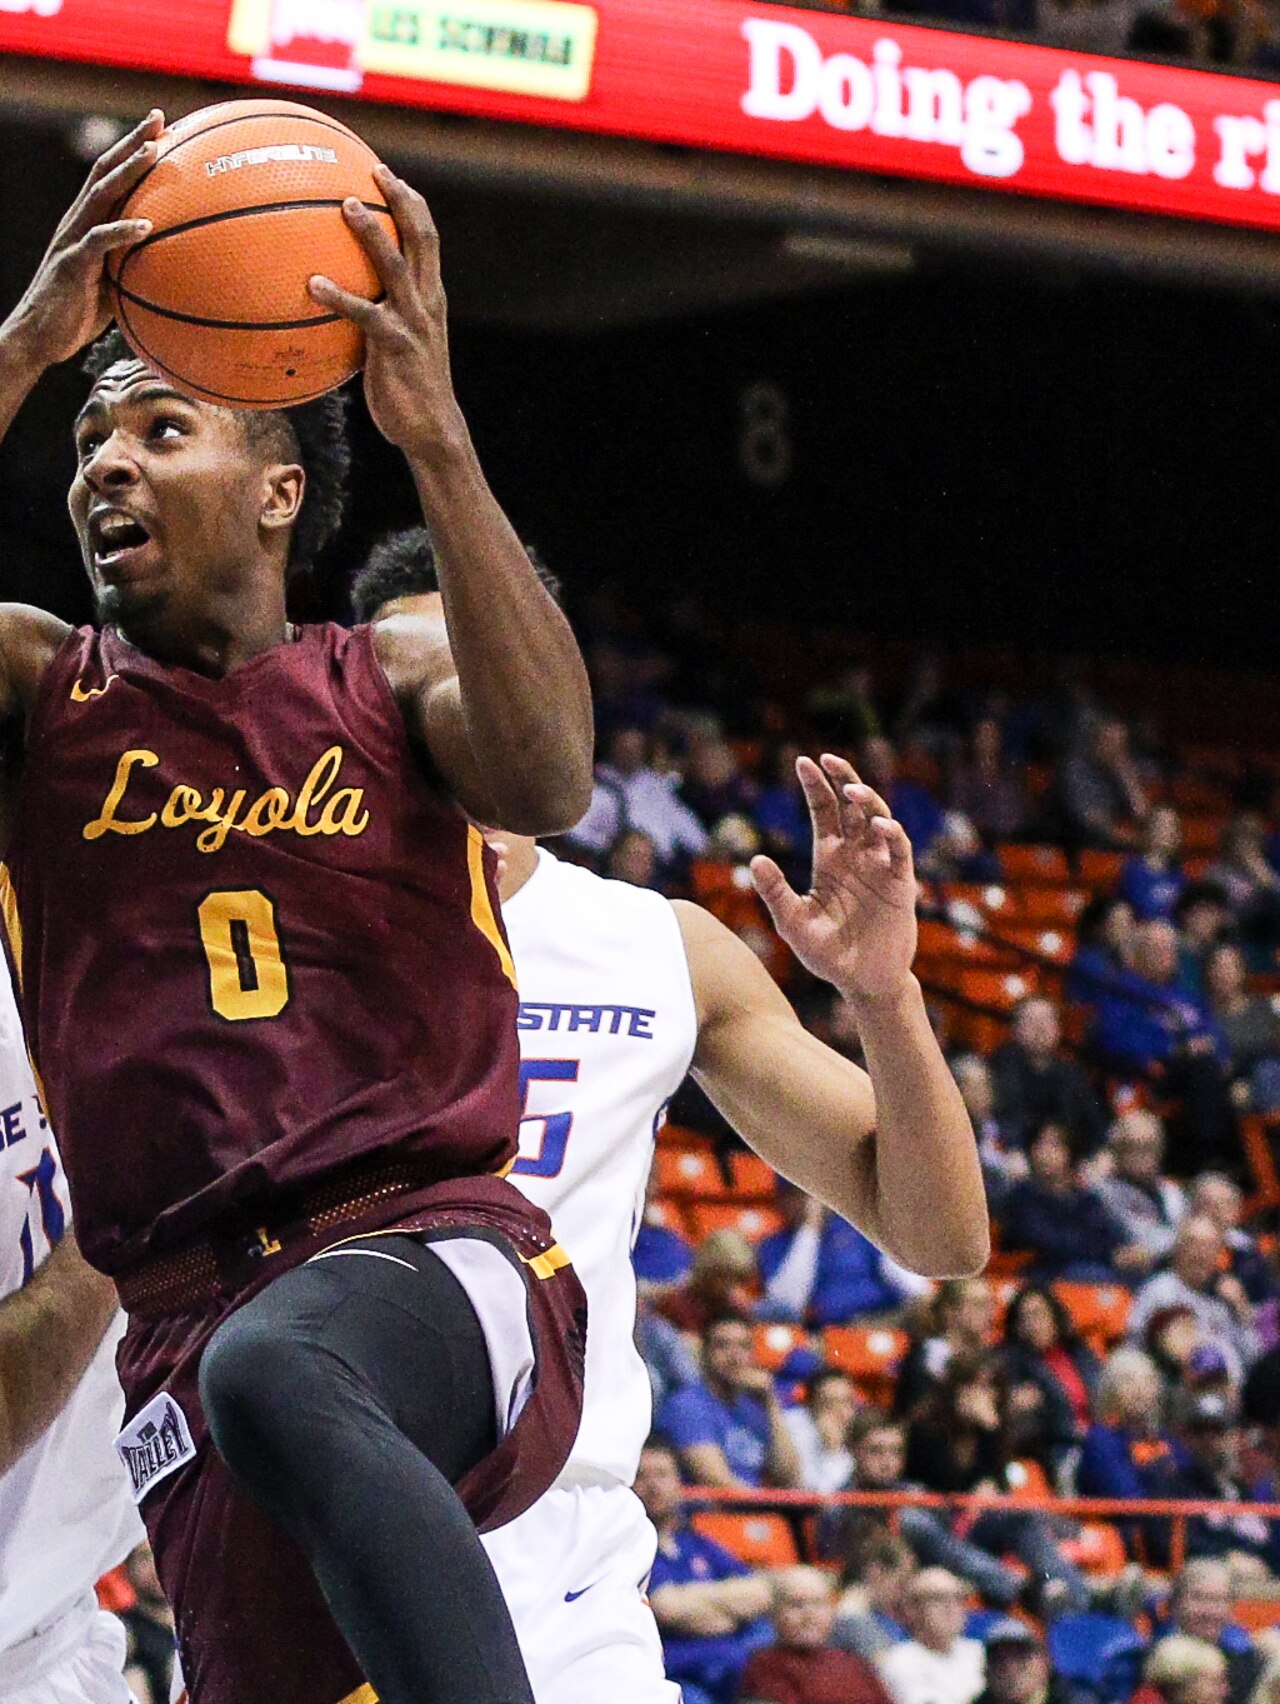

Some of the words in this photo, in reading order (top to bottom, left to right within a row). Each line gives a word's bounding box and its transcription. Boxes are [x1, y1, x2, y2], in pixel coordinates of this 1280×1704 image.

[740, 17, 1032, 178] Doing
[1049, 68, 1197, 180] the
[739, 382, 793, 487] 8
[82, 746, 370, 853] Loyola
[195, 887, 292, 1023] 0
[517, 1002, 657, 1040] STATE
[121, 1401, 189, 1494] VALLEY
